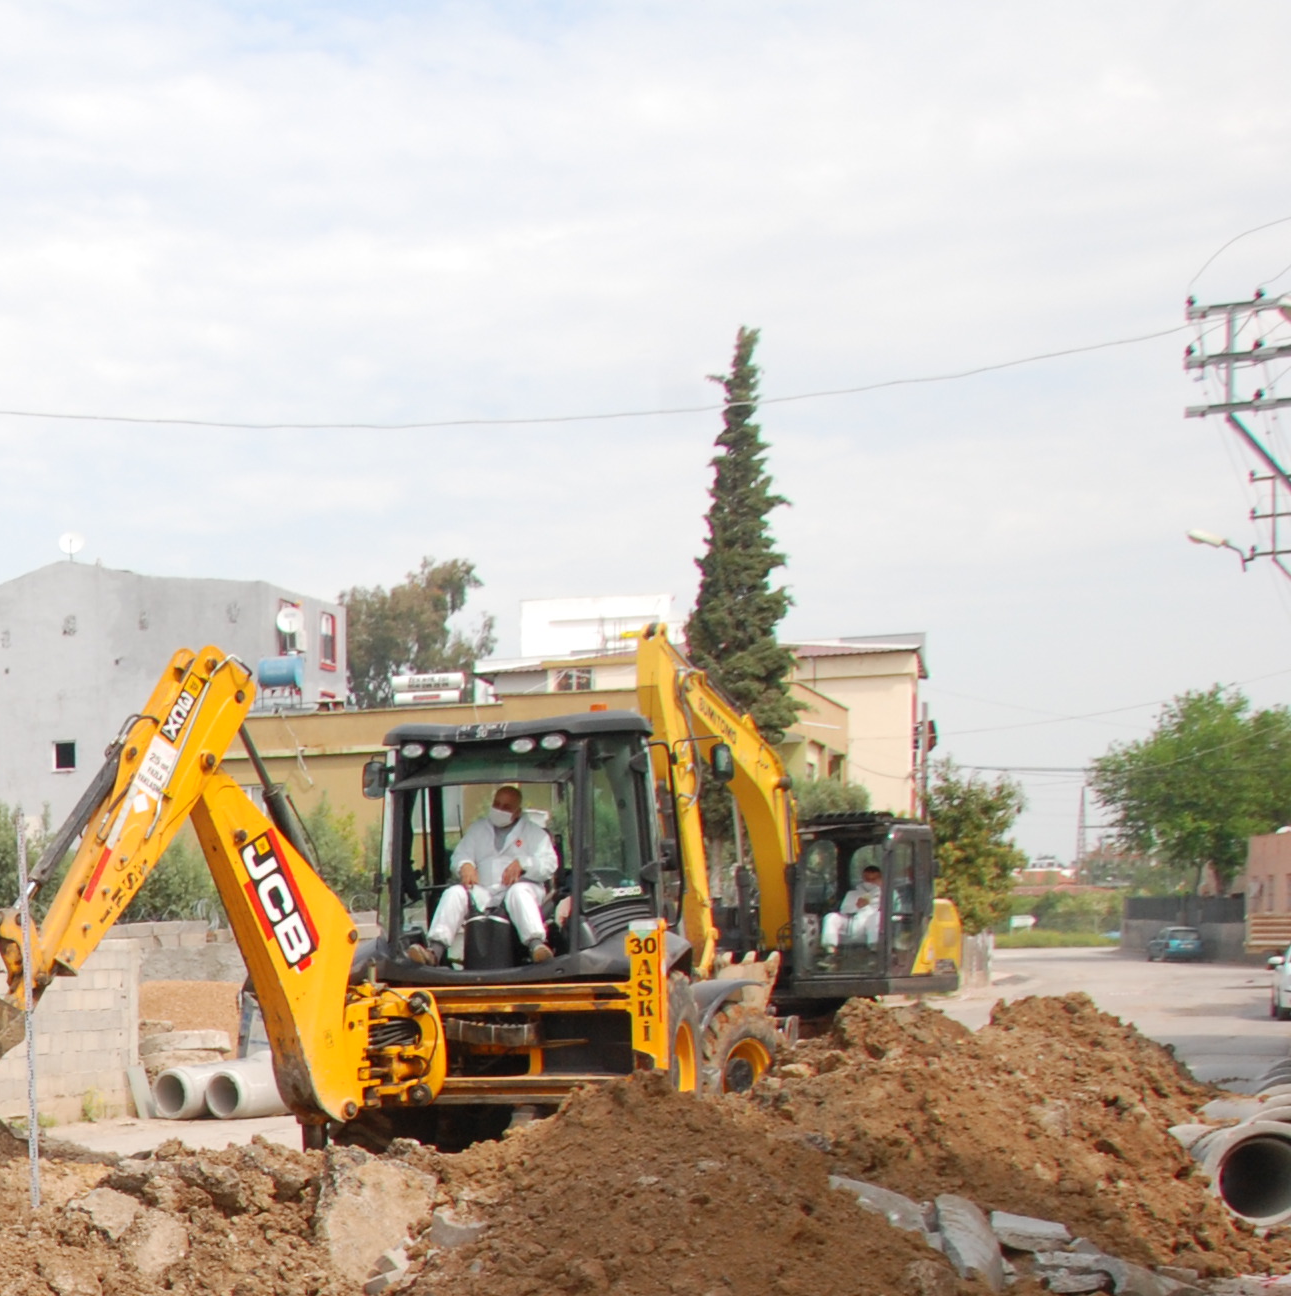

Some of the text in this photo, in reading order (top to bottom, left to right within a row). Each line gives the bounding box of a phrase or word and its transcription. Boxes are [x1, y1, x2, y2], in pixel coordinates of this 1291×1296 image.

[241, 844, 312, 964] JCB
[629, 937, 657, 955] 30
[637, 958, 654, 1042] ASKİ
